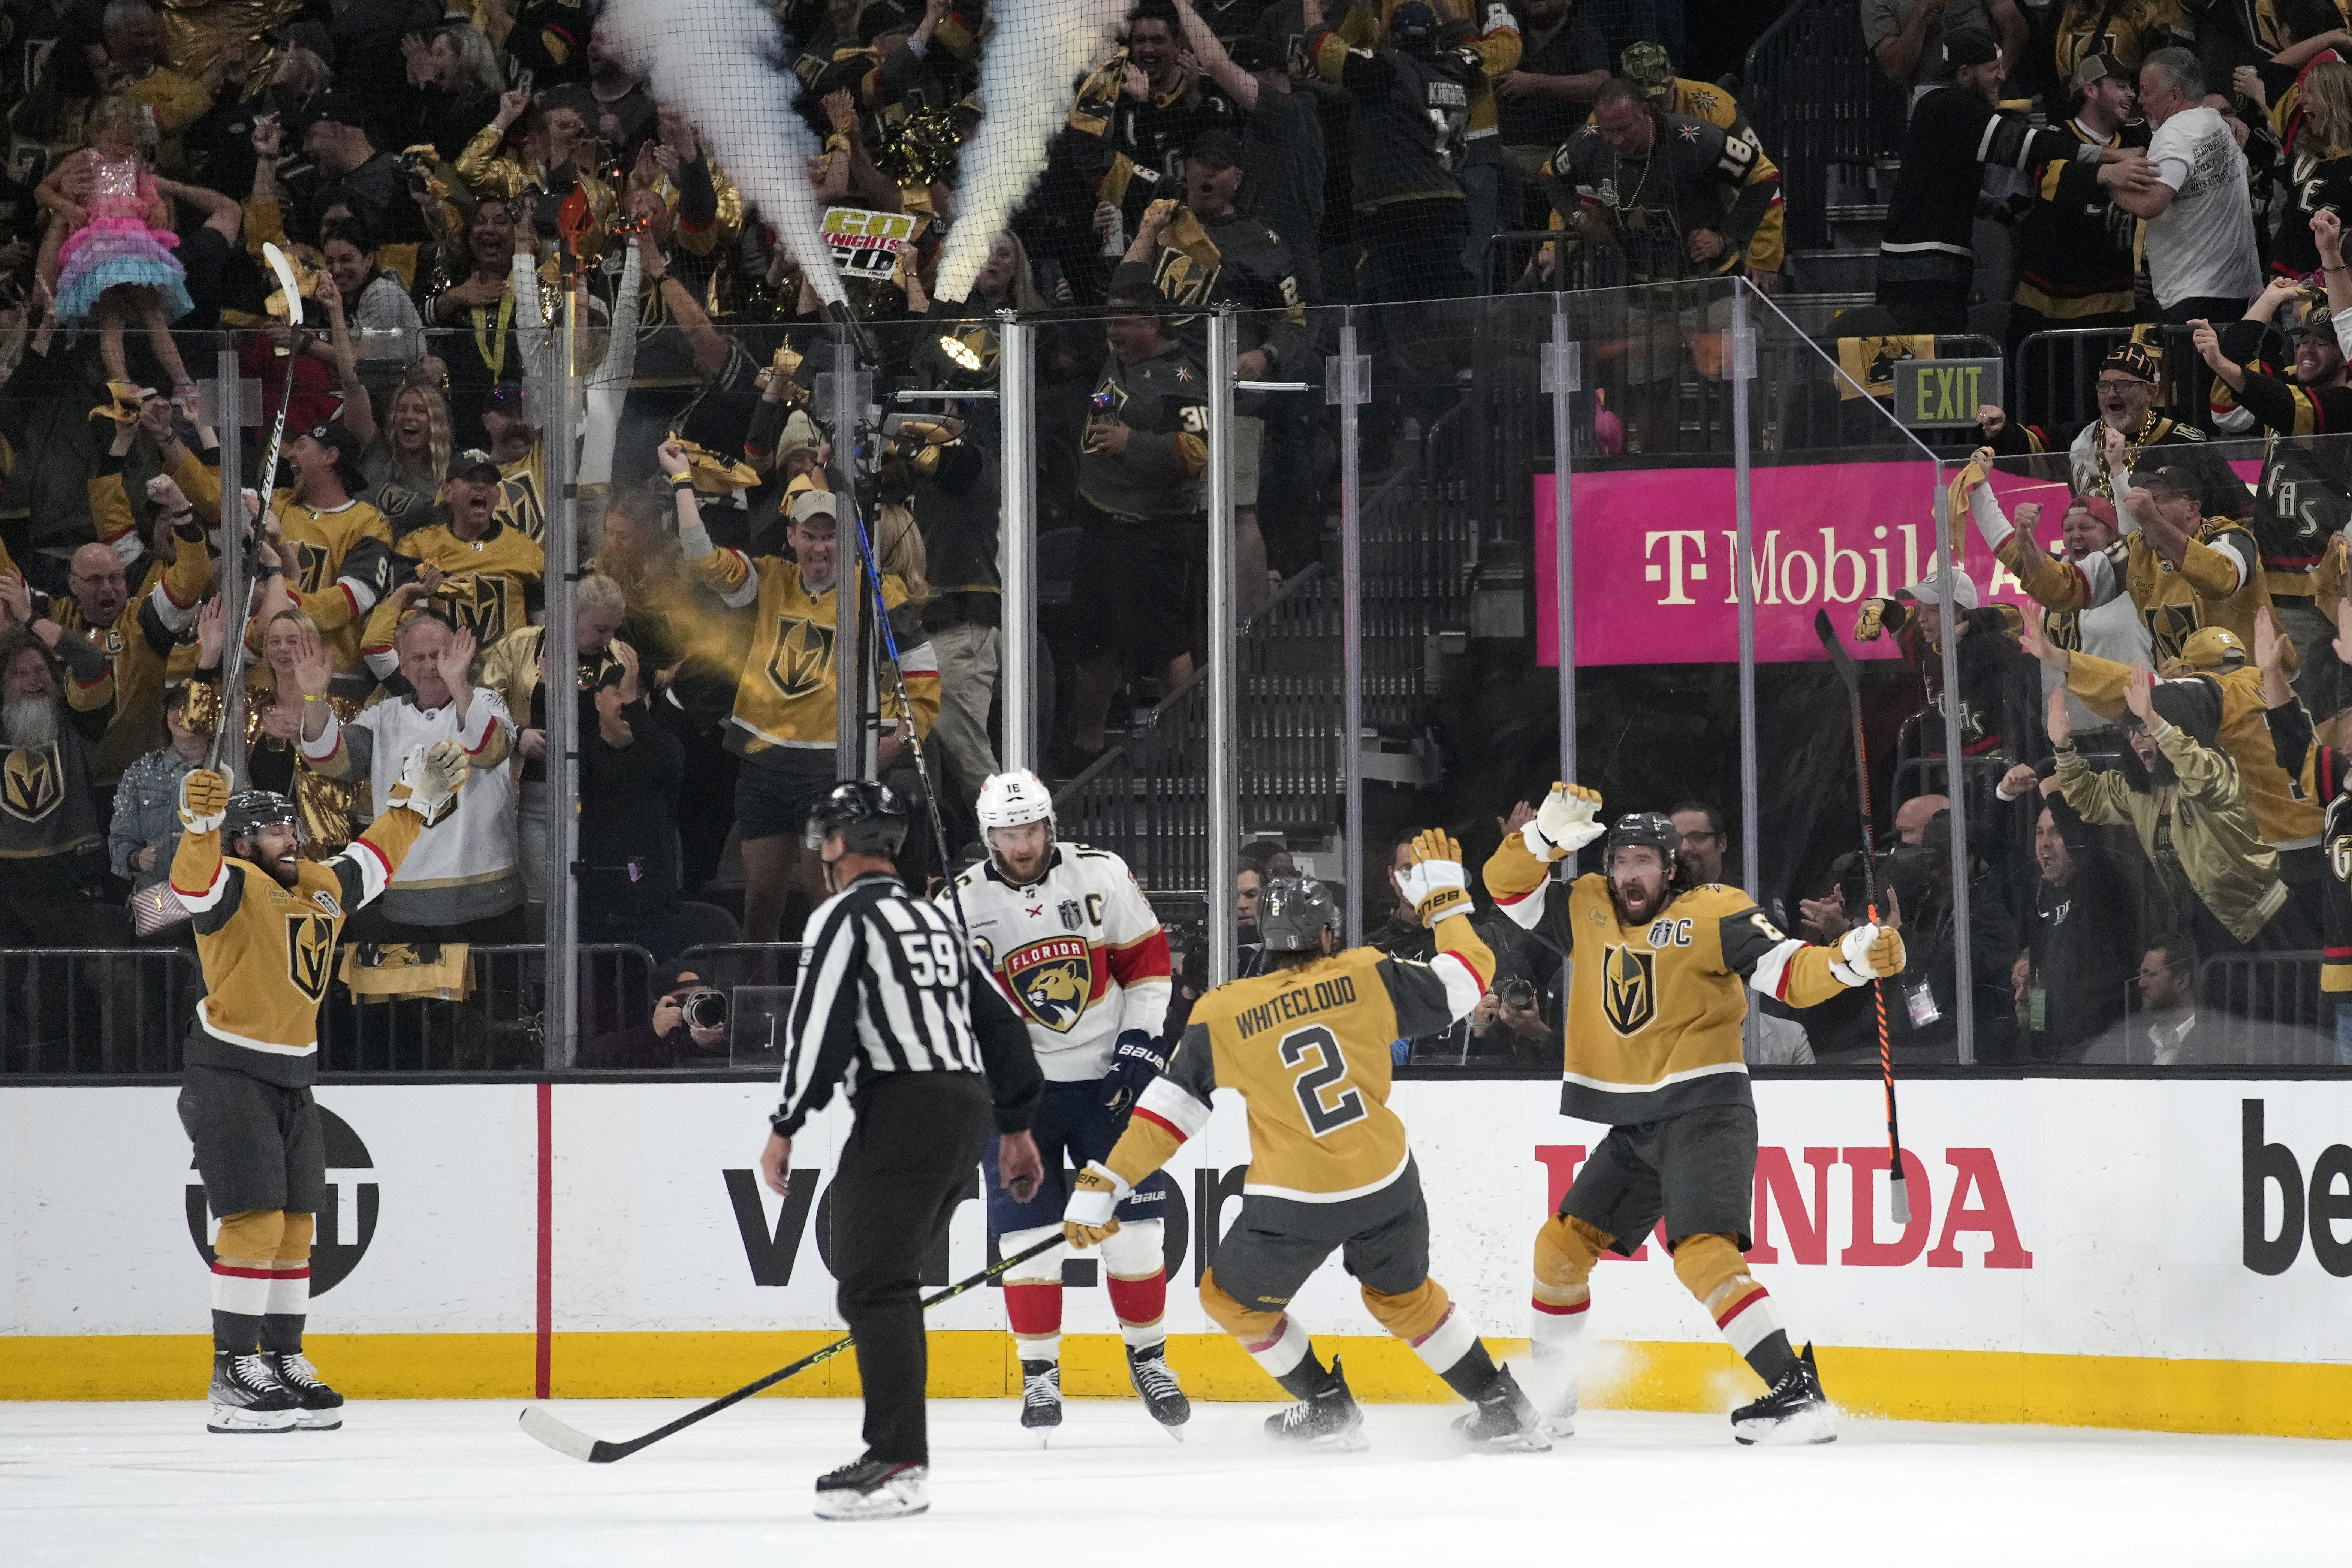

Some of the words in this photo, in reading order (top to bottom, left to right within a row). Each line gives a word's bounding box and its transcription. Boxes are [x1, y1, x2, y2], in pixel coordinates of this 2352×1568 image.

[826, 211, 911, 238] GO
[821, 232, 902, 251] KNIGHTS
[1917, 367, 1982, 420] EXIT
[1007, 783, 1020, 793] 16
[1085, 894, 1102, 928] C
[1271, 901, 1280, 916] 2
[1674, 917, 1694, 947] C
[900, 932, 959, 988] 59
[1011, 941, 1082, 971] FLORIDA
[1236, 974, 1357, 1040] WHITECLOUD
[1278, 1023, 1368, 1127] 2
[2242, 1098, 2352, 1277] be
